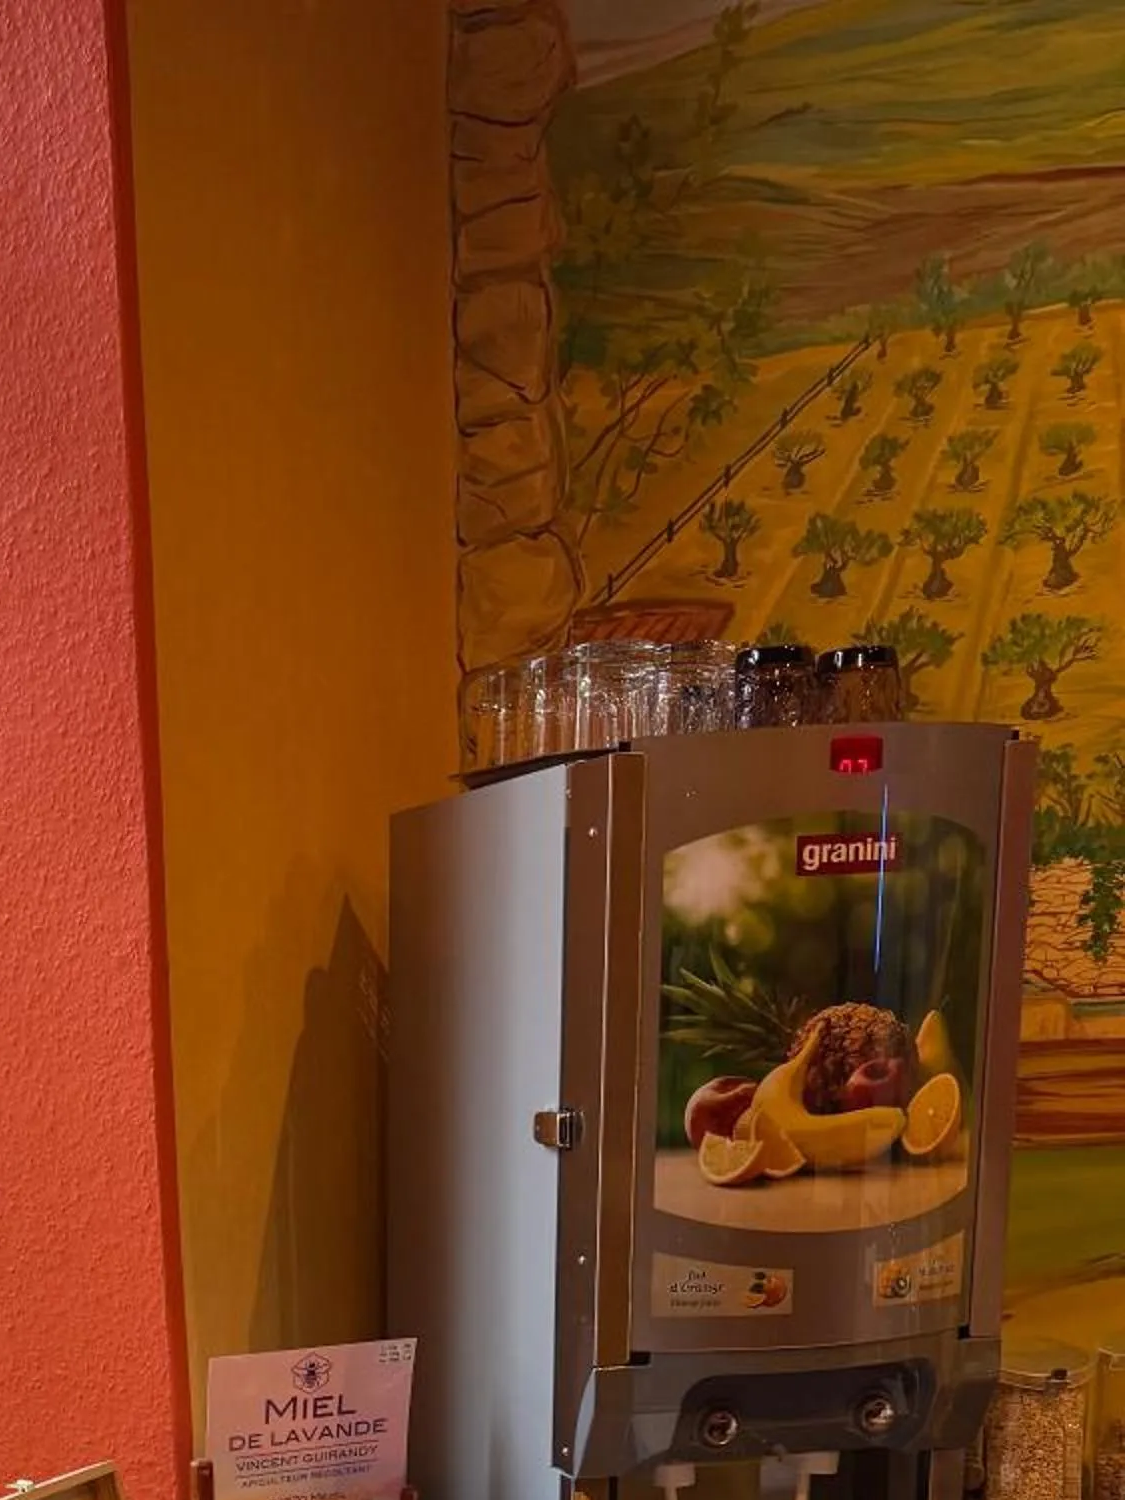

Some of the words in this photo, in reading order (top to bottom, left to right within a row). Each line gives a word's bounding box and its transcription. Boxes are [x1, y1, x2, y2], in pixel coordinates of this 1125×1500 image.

[802, 837, 897, 871] granini
[264, 1395, 357, 1425] MIEL
[228, 1433, 263, 1452] DE
[270, 1418, 389, 1447] LAVANDE
[235, 1454, 299, 1472] VINCENT
